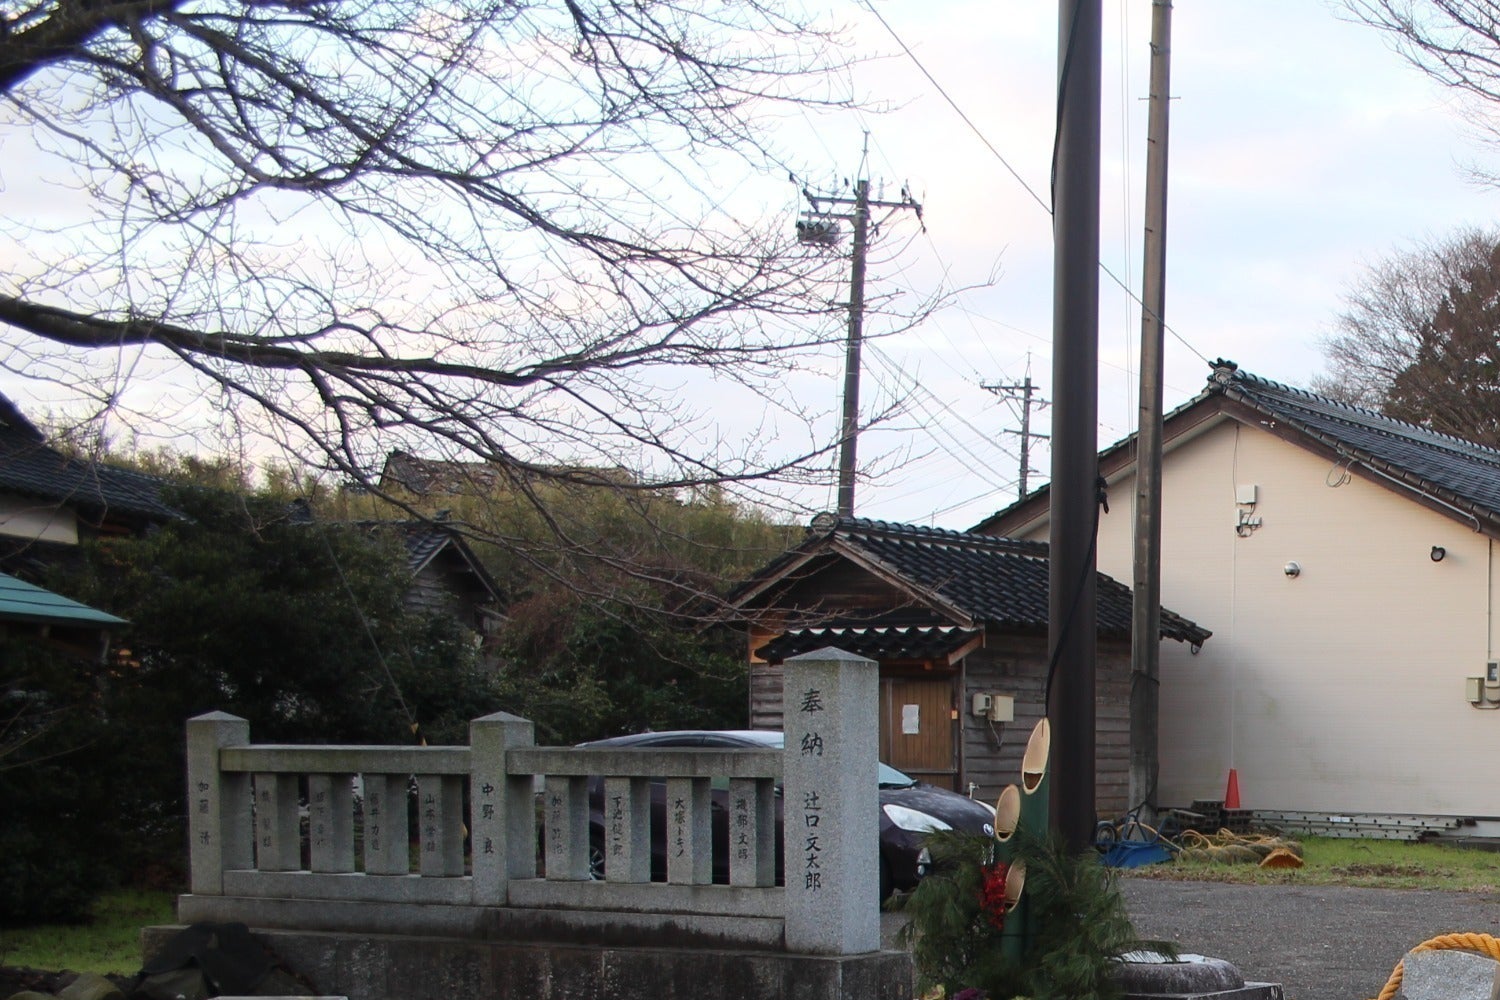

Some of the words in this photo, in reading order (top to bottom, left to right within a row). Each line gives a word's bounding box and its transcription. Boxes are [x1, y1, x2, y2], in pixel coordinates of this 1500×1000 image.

[801, 688, 825, 757] 奉納
[482, 782, 495, 855] 中野良
[805, 791, 822, 892] 辻口文太郎
